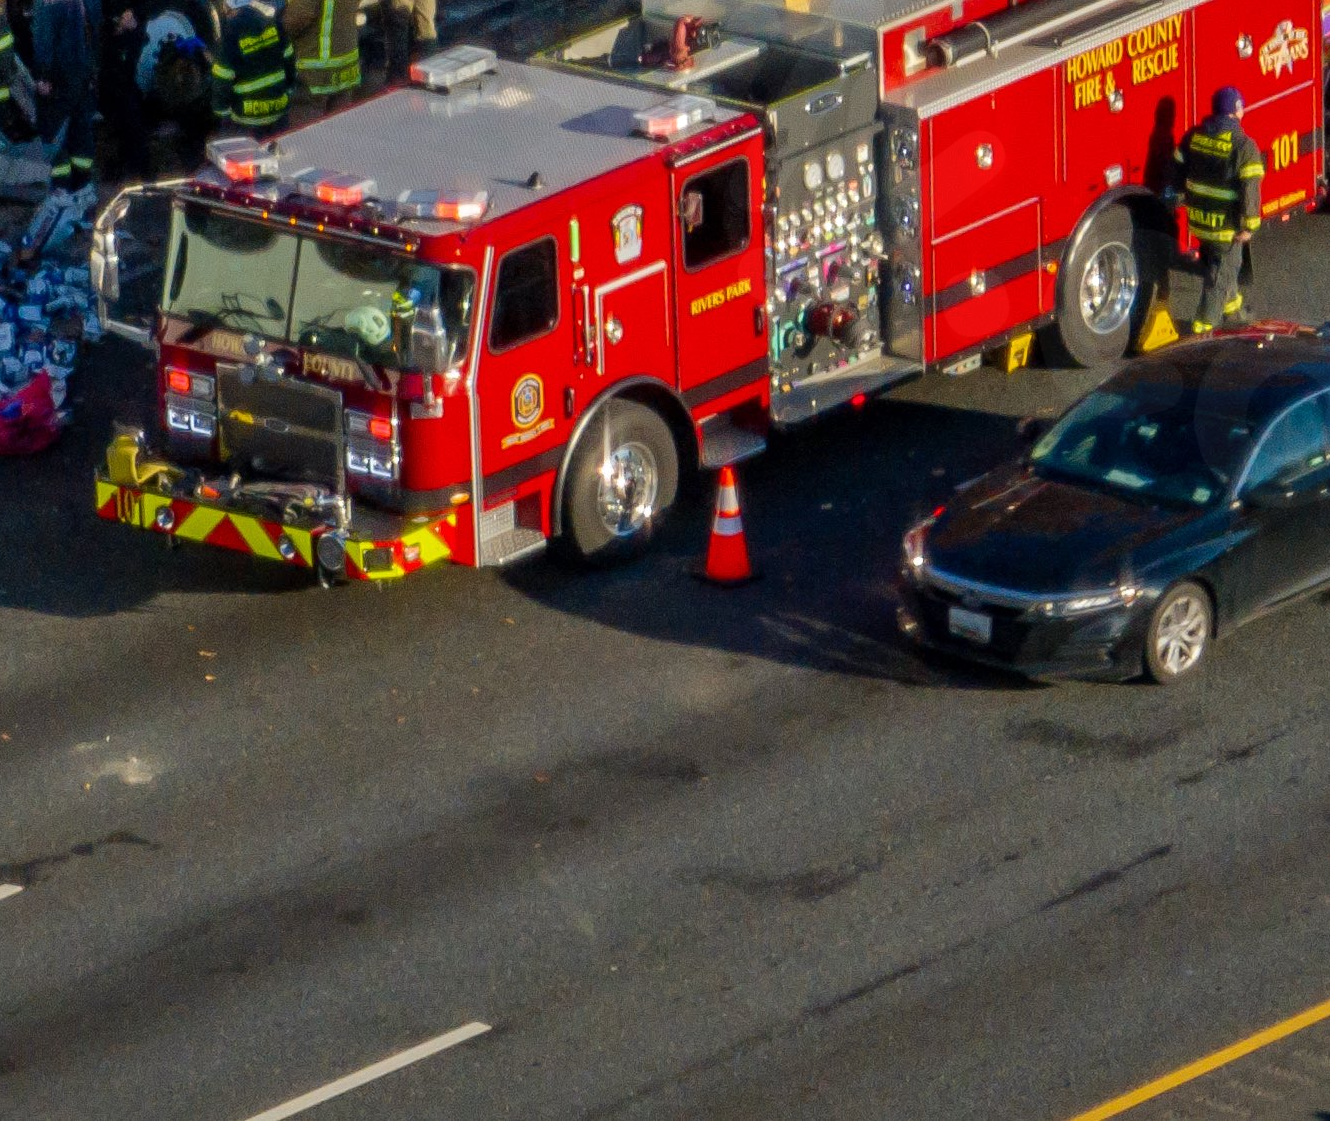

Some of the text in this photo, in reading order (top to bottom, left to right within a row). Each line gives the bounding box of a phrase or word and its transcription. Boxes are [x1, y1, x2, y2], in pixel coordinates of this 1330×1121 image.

[1066, 13, 1183, 84] HOWARD COUNTY
[1073, 42, 1179, 111] FIRE & RESCUE
[1271, 129, 1299, 171] 101
[691, 278, 752, 317] RIVERS PARK
